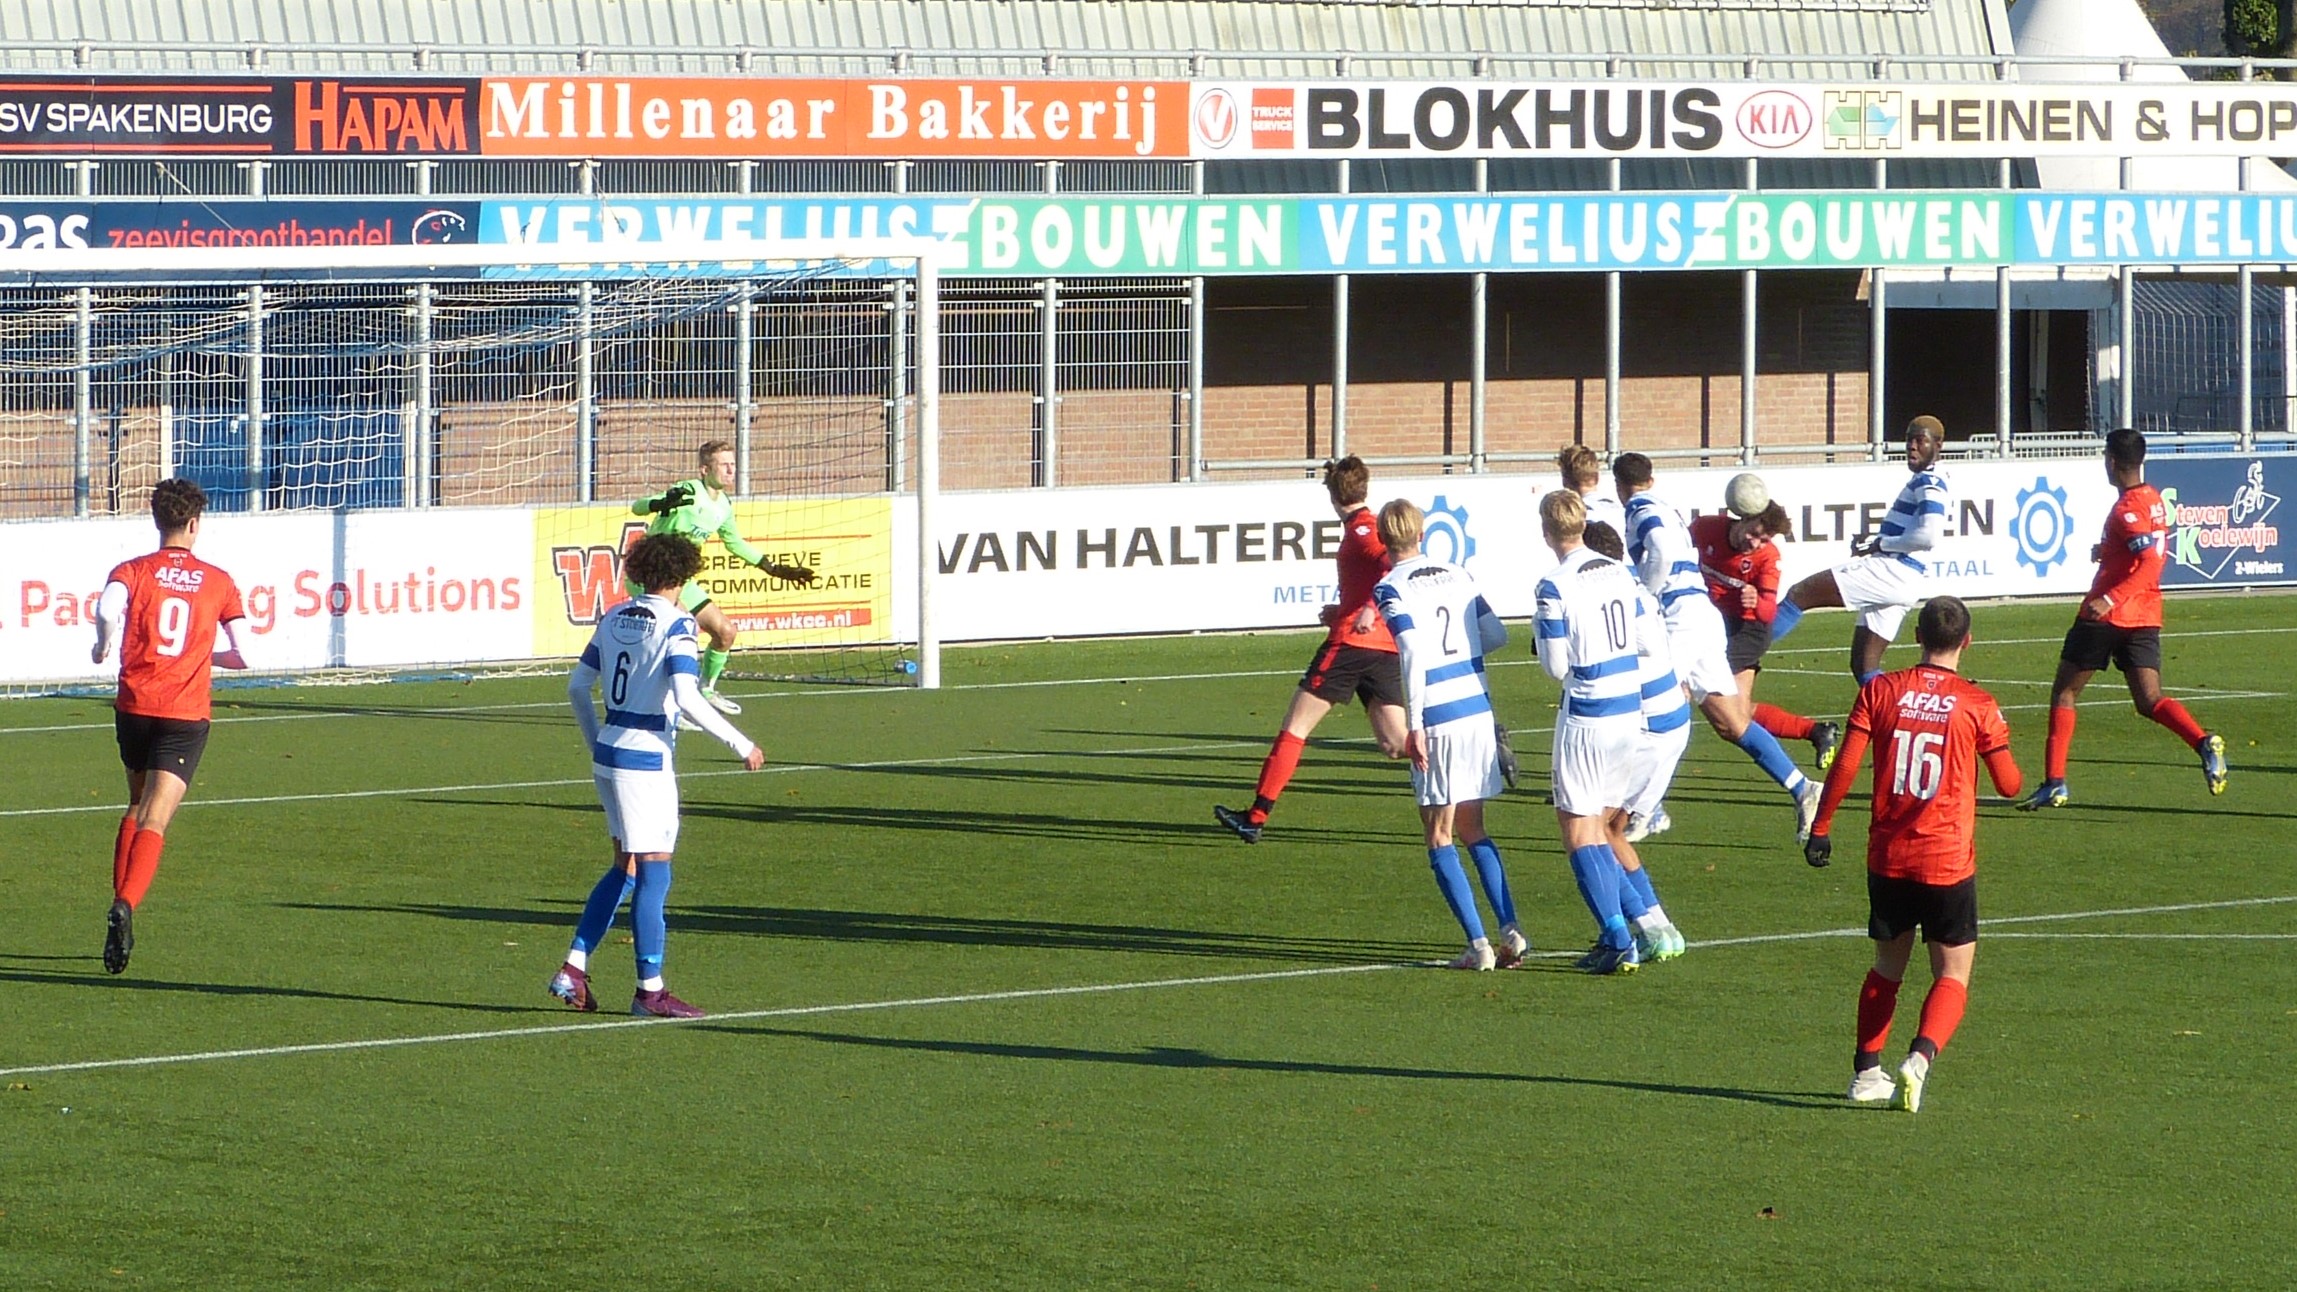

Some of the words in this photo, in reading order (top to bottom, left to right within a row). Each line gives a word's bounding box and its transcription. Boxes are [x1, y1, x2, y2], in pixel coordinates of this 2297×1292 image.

[0, 103, 40, 133] SV
[47, 103, 272, 134] SPAKENBURG
[294, 82, 468, 151] HAPAM
[486, 82, 835, 139] Millenaar
[867, 84, 1156, 155] Bakkerij
[1252, 106, 1293, 118] TRUCK
[1252, 119, 1293, 131] SERVICE
[1307, 87, 1723, 151] BLOKHUIS
[1750, 103, 1799, 135] KIA
[1911, 100, 2112, 142] HEINEN
[2135, 100, 2170, 141] &
[2191, 100, 2297, 141] HOP
[981, 204, 1282, 269] BOUWEN
[1318, 202, 1683, 265] VERWELIUS
[1736, 201, 2000, 261] BOUWEN
[2160, 488, 2229, 526] Steven
[938, 530, 1057, 575] VAN
[1077, 520, 1341, 569] HALTERE
[2176, 524, 2278, 564] Koelewijn
[155, 566, 204, 585] AFAS
[2235, 560, 2284, 575] 2-Wielers
[294, 566, 520, 618] Solutions
[157, 597, 190, 657] 9
[731, 611, 851, 632] ww.wkcc.nl
[1436, 605, 1458, 656] 2
[1601, 599, 1627, 652] 10
[610, 650, 632, 705] 6
[1897, 690, 1957, 712] AFAS
[1899, 708, 1949, 723] software
[1893, 729, 1945, 800] 16
